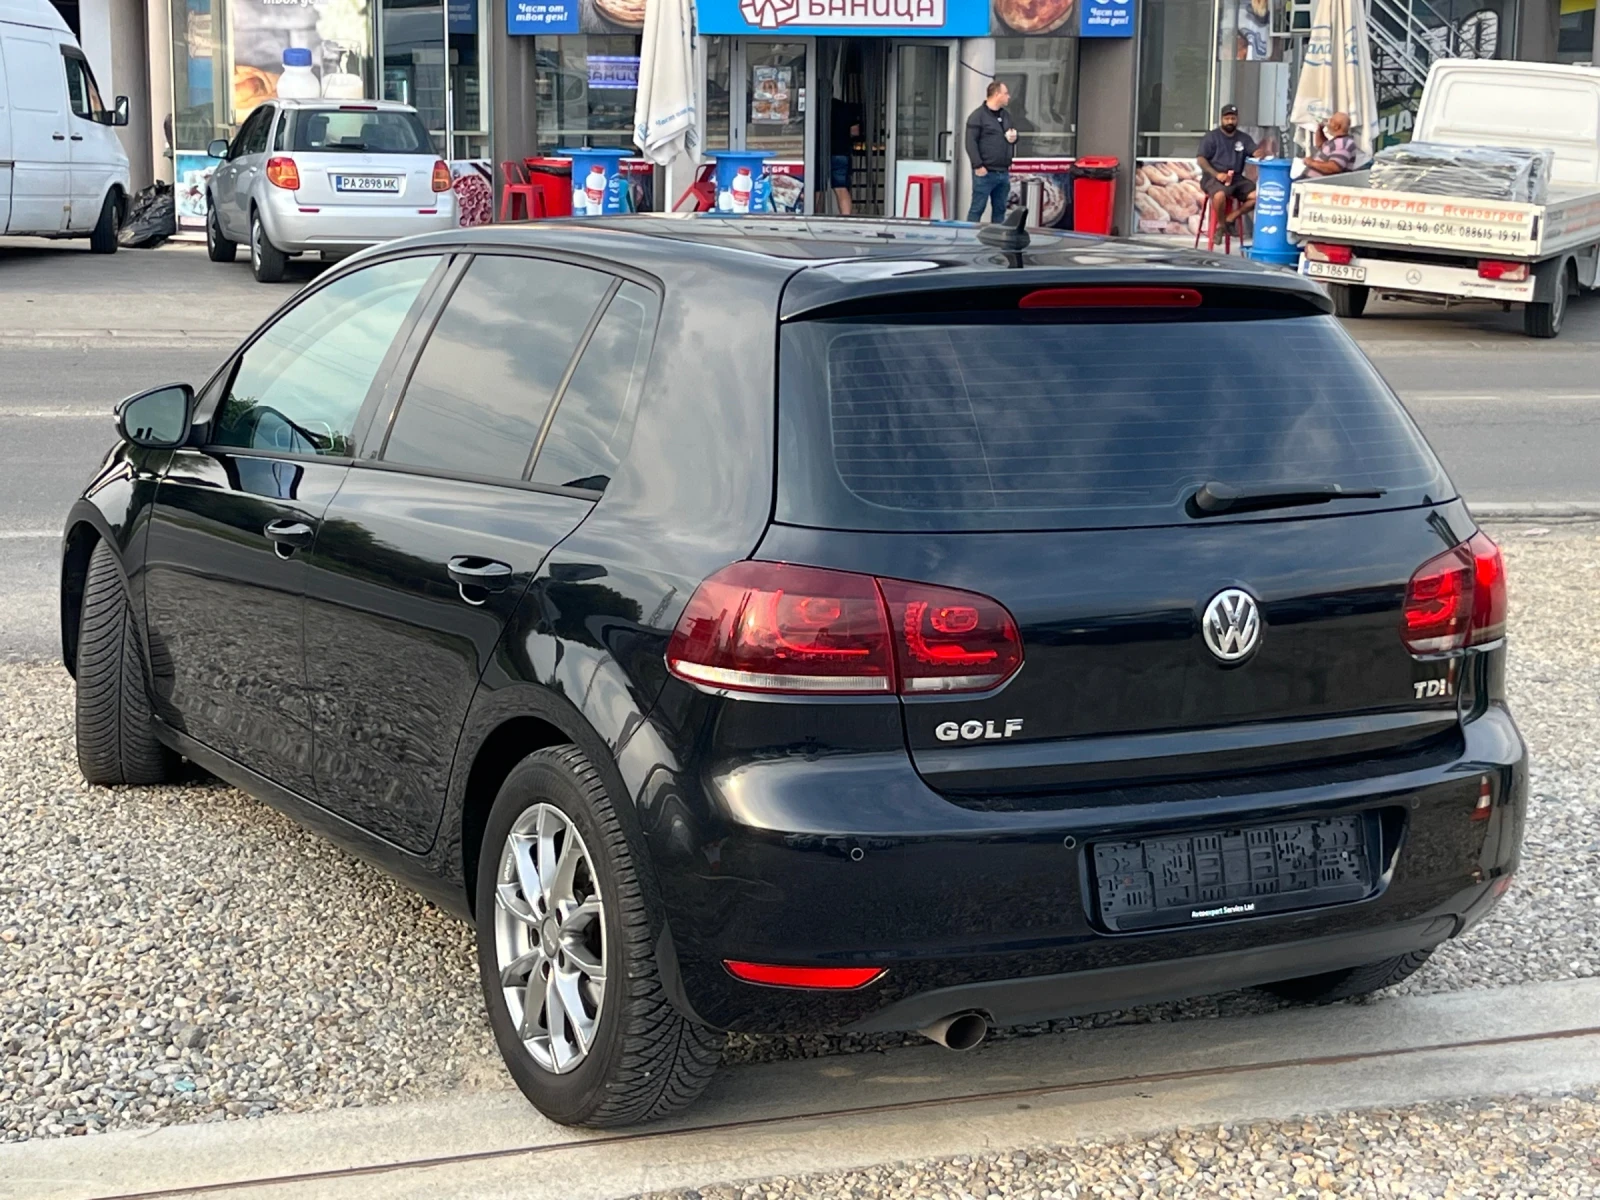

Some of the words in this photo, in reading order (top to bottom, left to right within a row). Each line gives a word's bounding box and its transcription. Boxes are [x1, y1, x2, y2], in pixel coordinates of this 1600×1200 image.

[518, 3, 546, 13] Част
[548, 5, 564, 13] от
[808, 0, 934, 21] БАНИЦА
[516, 13, 544, 21] твоя
[545, 12, 568, 24] ден!
[358, 179, 382, 188] 2898
[1397, 219, 1412, 231] 623
[1327, 265, 1349, 277] 1869
[935, 718, 1024, 741] GOLF
